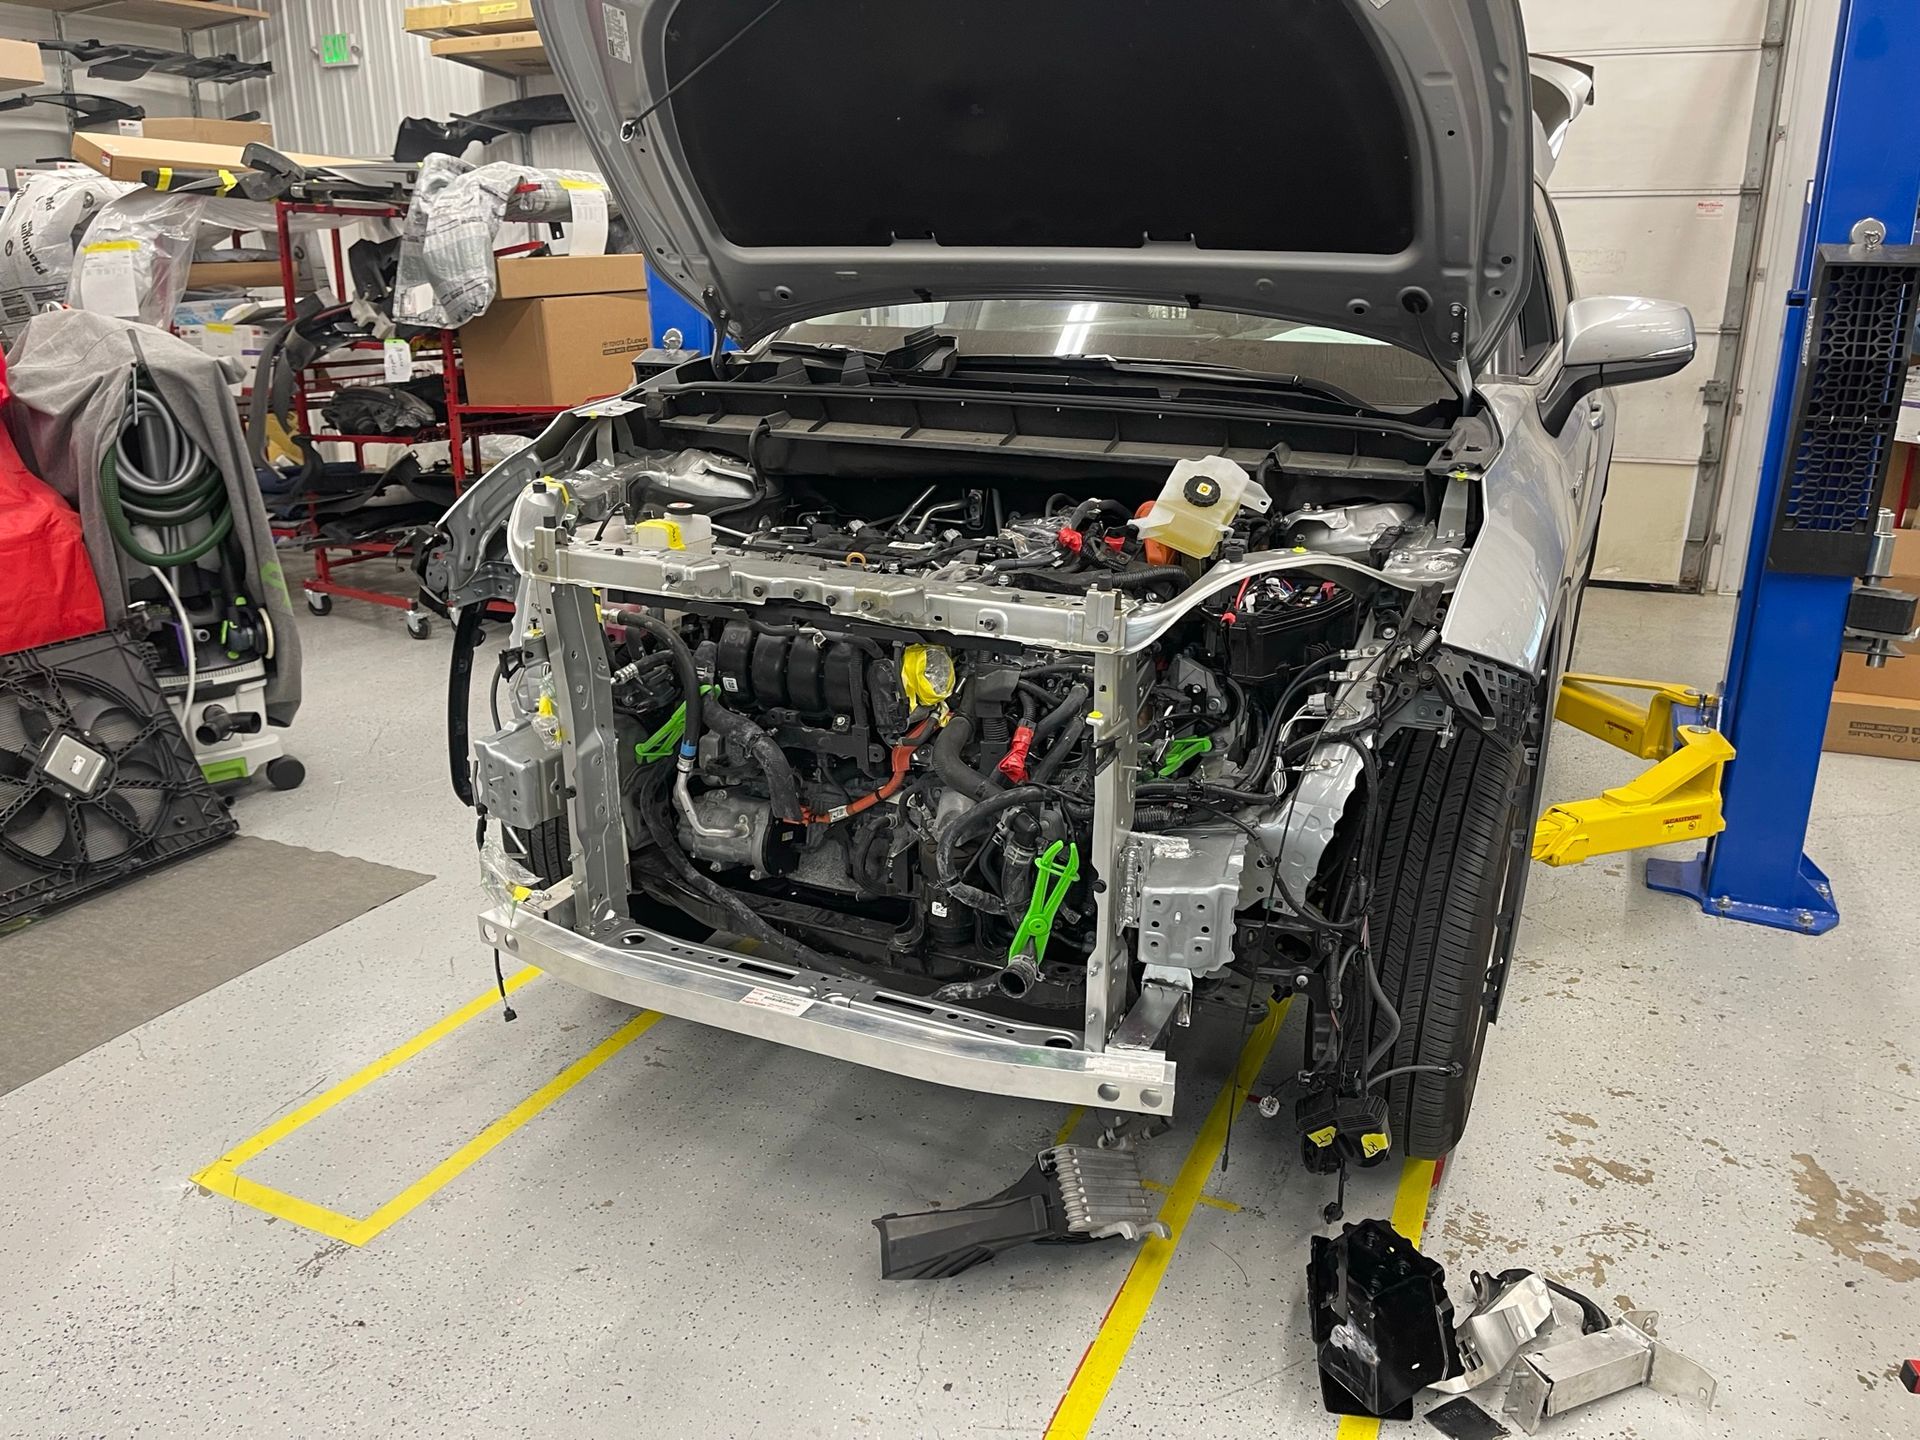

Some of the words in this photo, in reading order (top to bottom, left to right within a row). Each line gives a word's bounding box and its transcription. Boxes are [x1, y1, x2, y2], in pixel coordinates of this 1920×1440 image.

[323, 33, 349, 64] EXIT
[21, 222, 49, 275] Platinum
[1668, 814, 1700, 824] CAUTION
